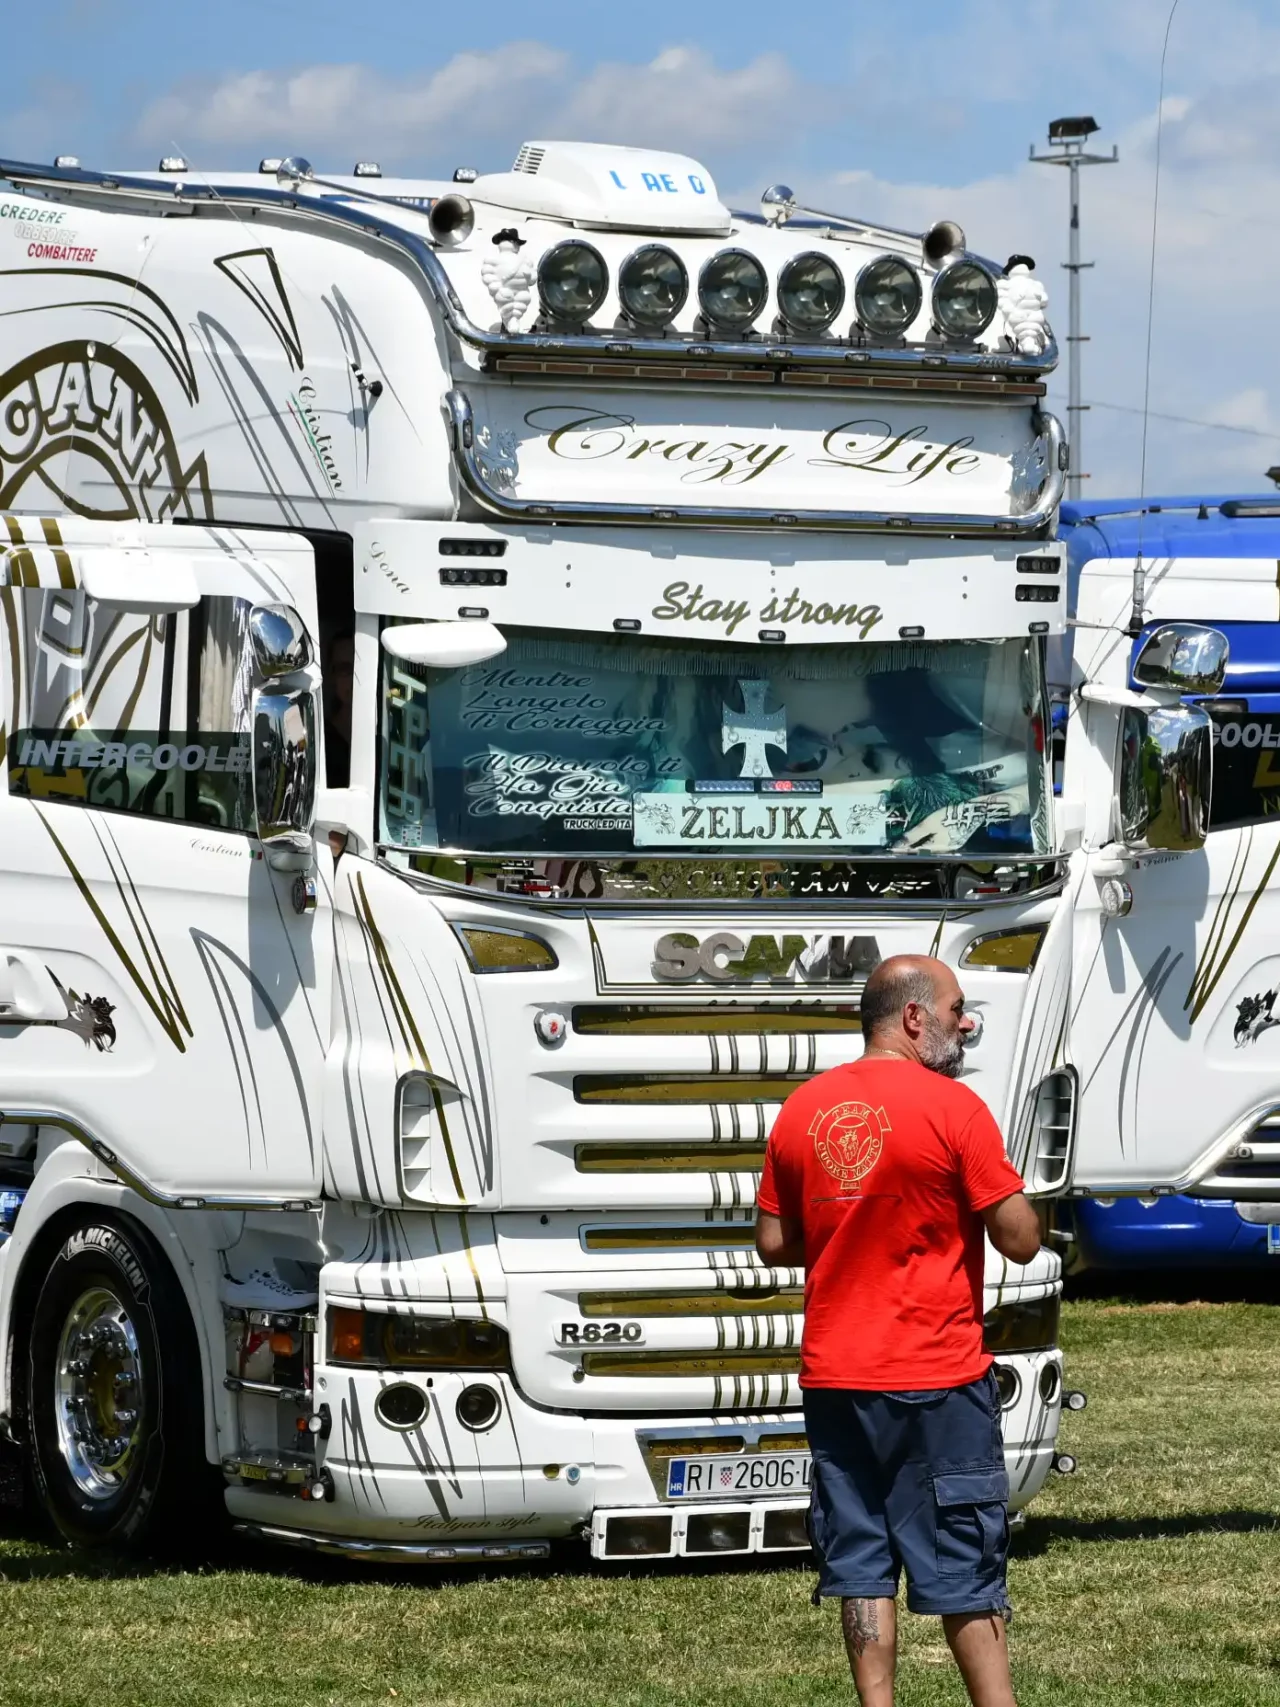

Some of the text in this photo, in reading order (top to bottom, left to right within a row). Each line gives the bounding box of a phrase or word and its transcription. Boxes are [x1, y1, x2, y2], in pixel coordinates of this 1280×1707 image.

[0, 203, 67, 224] CREDERE
[14, 221, 78, 246] OBBEDIRE
[27, 243, 98, 262] COMBATTERE
[299, 376, 345, 493] Cristian
[523, 405, 980, 487] Crazy Life
[652, 581, 883, 640] Stay strong
[460, 669, 593, 689] Mentre
[463, 707, 667, 737] Ti Corteggia
[18, 739, 253, 773] INTERCOOLE
[511, 753, 650, 774] Diavolo
[657, 756, 684, 773] ti
[464, 773, 627, 800] Ha Gia
[564, 819, 595, 830] TRUCK
[597, 819, 615, 830] LED
[190, 838, 244, 857] Cristian
[651, 932, 885, 980] SCANIA
[831, 1105, 871, 1120] TEAM
[817, 1138, 881, 1179] CUORE MATTO
[84, 1227, 145, 1288] MICHELIN
[561, 1322, 642, 1344] R620
[669, 1482, 683, 1492] HR
[687, 1463, 714, 1492] RI
